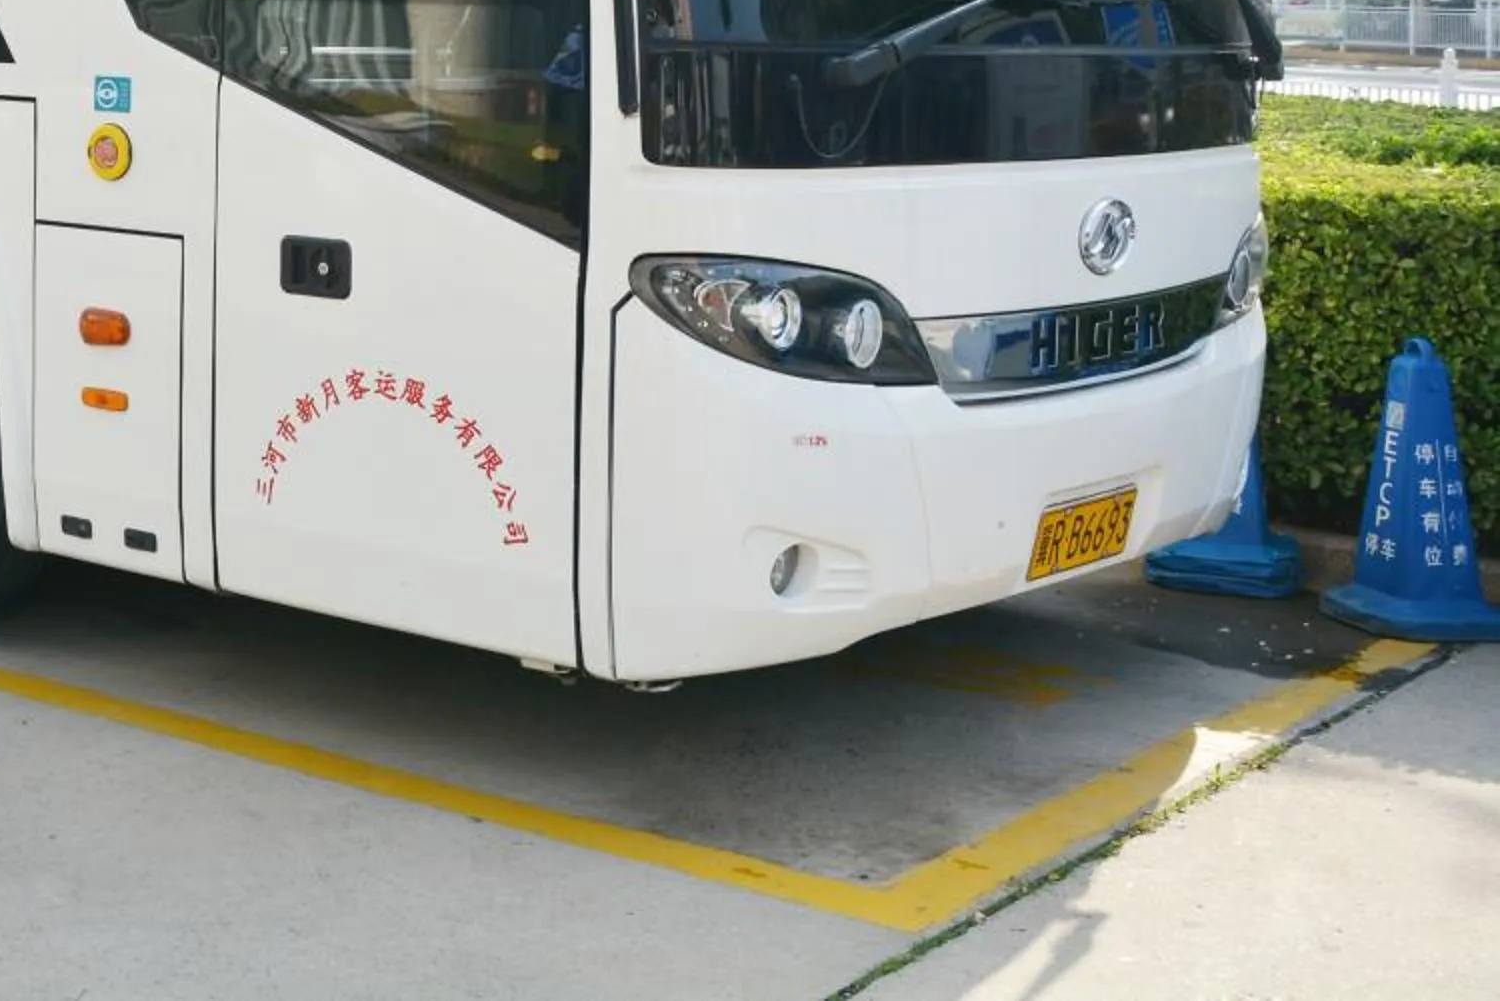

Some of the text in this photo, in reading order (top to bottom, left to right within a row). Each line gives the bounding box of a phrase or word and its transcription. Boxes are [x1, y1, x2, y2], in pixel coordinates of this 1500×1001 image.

[1030, 301, 1166, 375] HIGER
[256, 369, 529, 546] 三河市新月客运服务有限公司
[1374, 430, 1400, 528] ETCP
